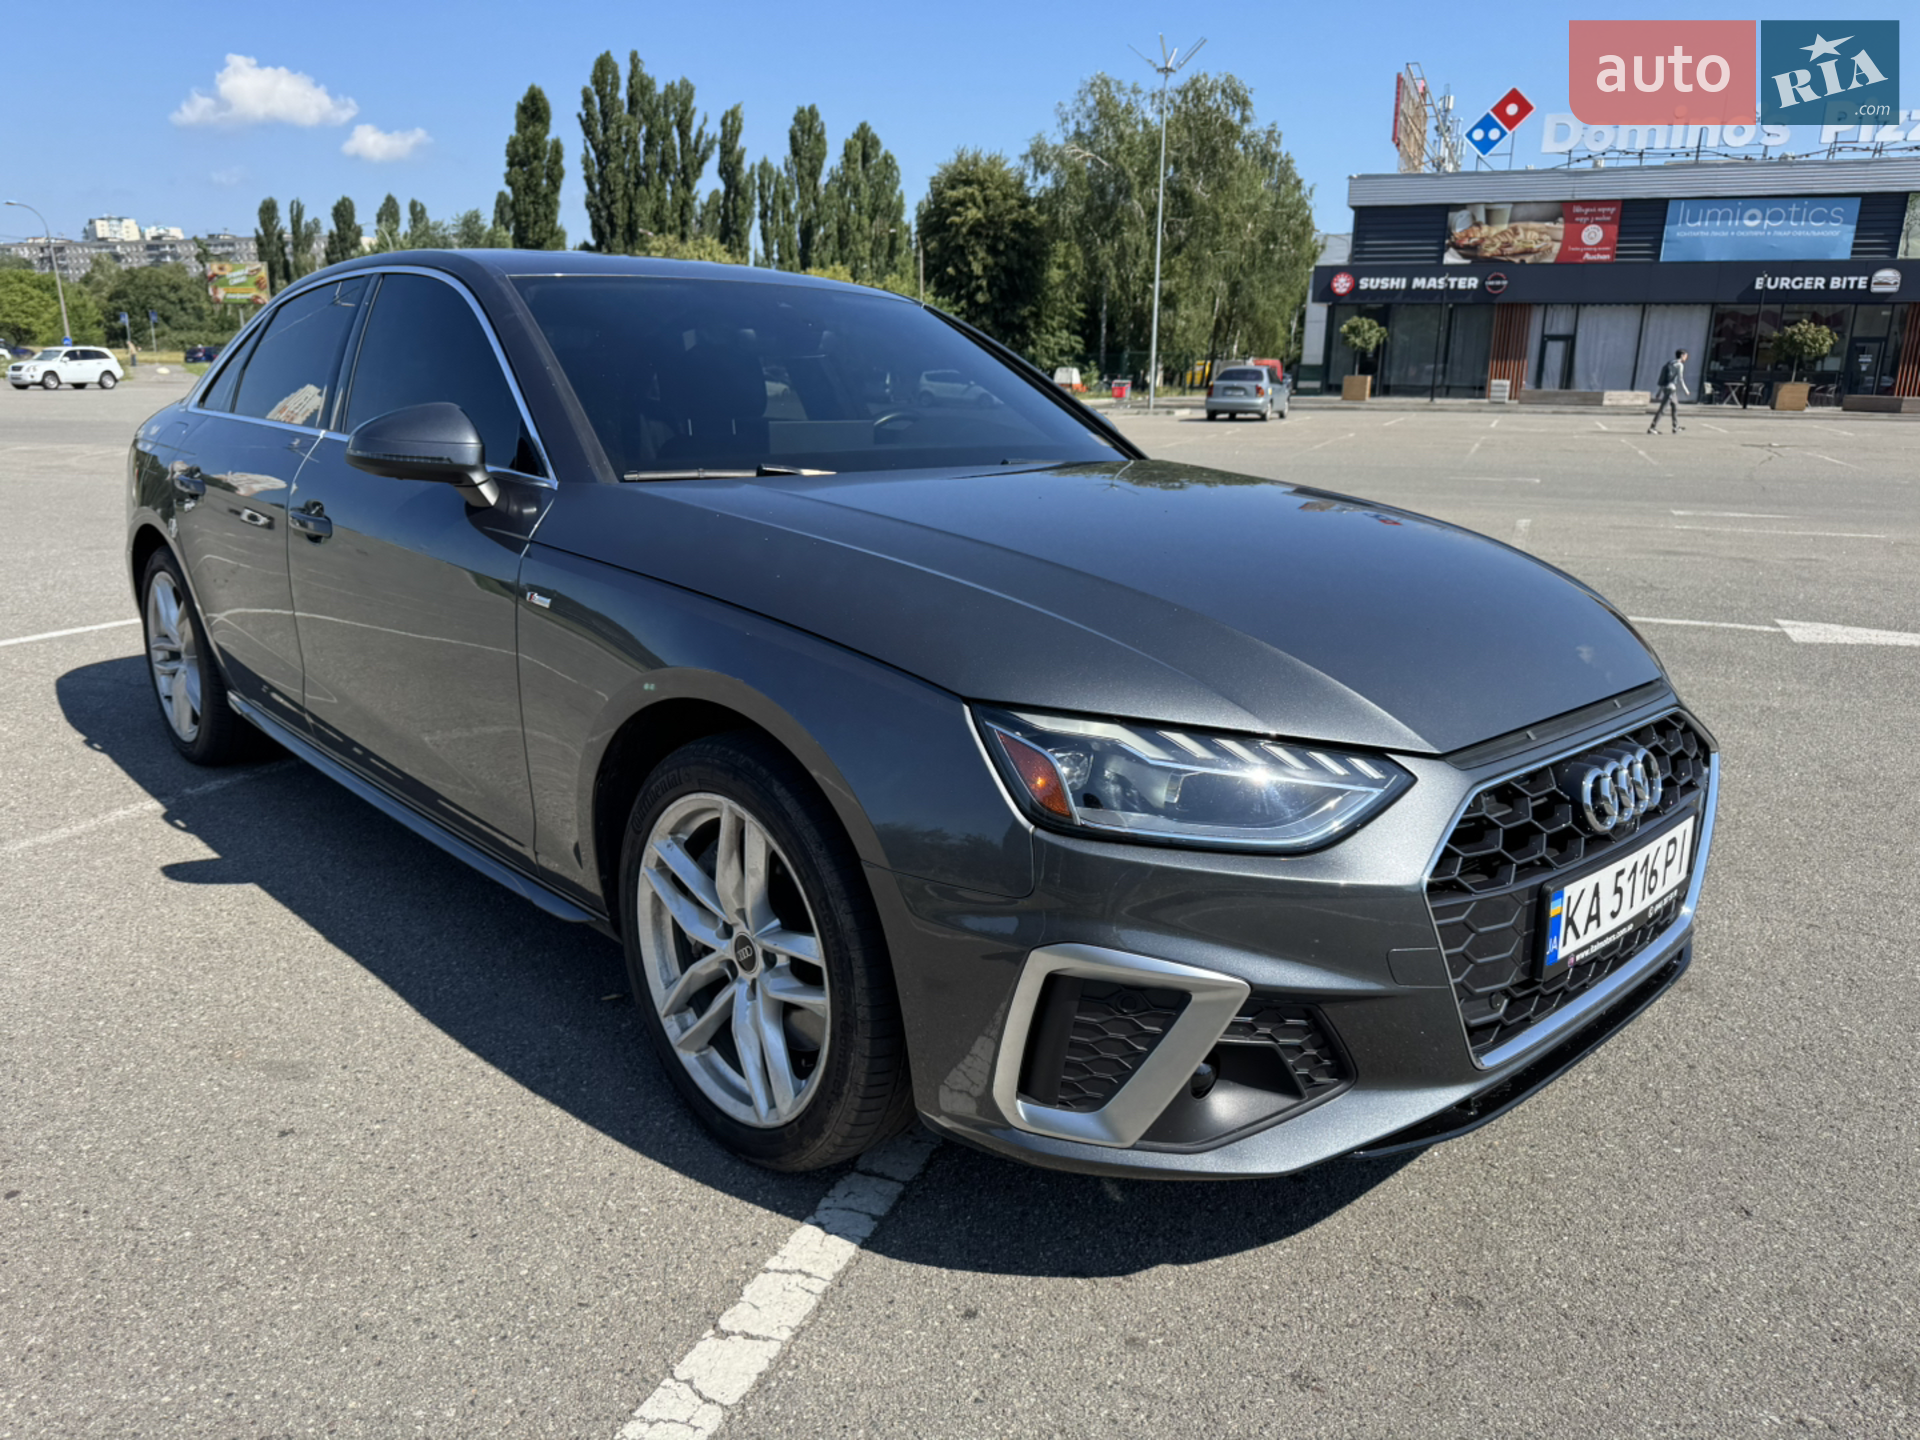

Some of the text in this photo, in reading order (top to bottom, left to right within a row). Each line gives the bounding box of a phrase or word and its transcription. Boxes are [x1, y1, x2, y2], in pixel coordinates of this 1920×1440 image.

[1677, 201, 1845, 230] lumioptics
[1358, 276, 1407, 290] SUSHI
[1411, 276, 1479, 290] MASTER
[1754, 276, 1869, 290] BURGER BITE
[1561, 881, 1601, 949] KA
[1610, 844, 1662, 920] 5116
[1662, 828, 1688, 887] PI
